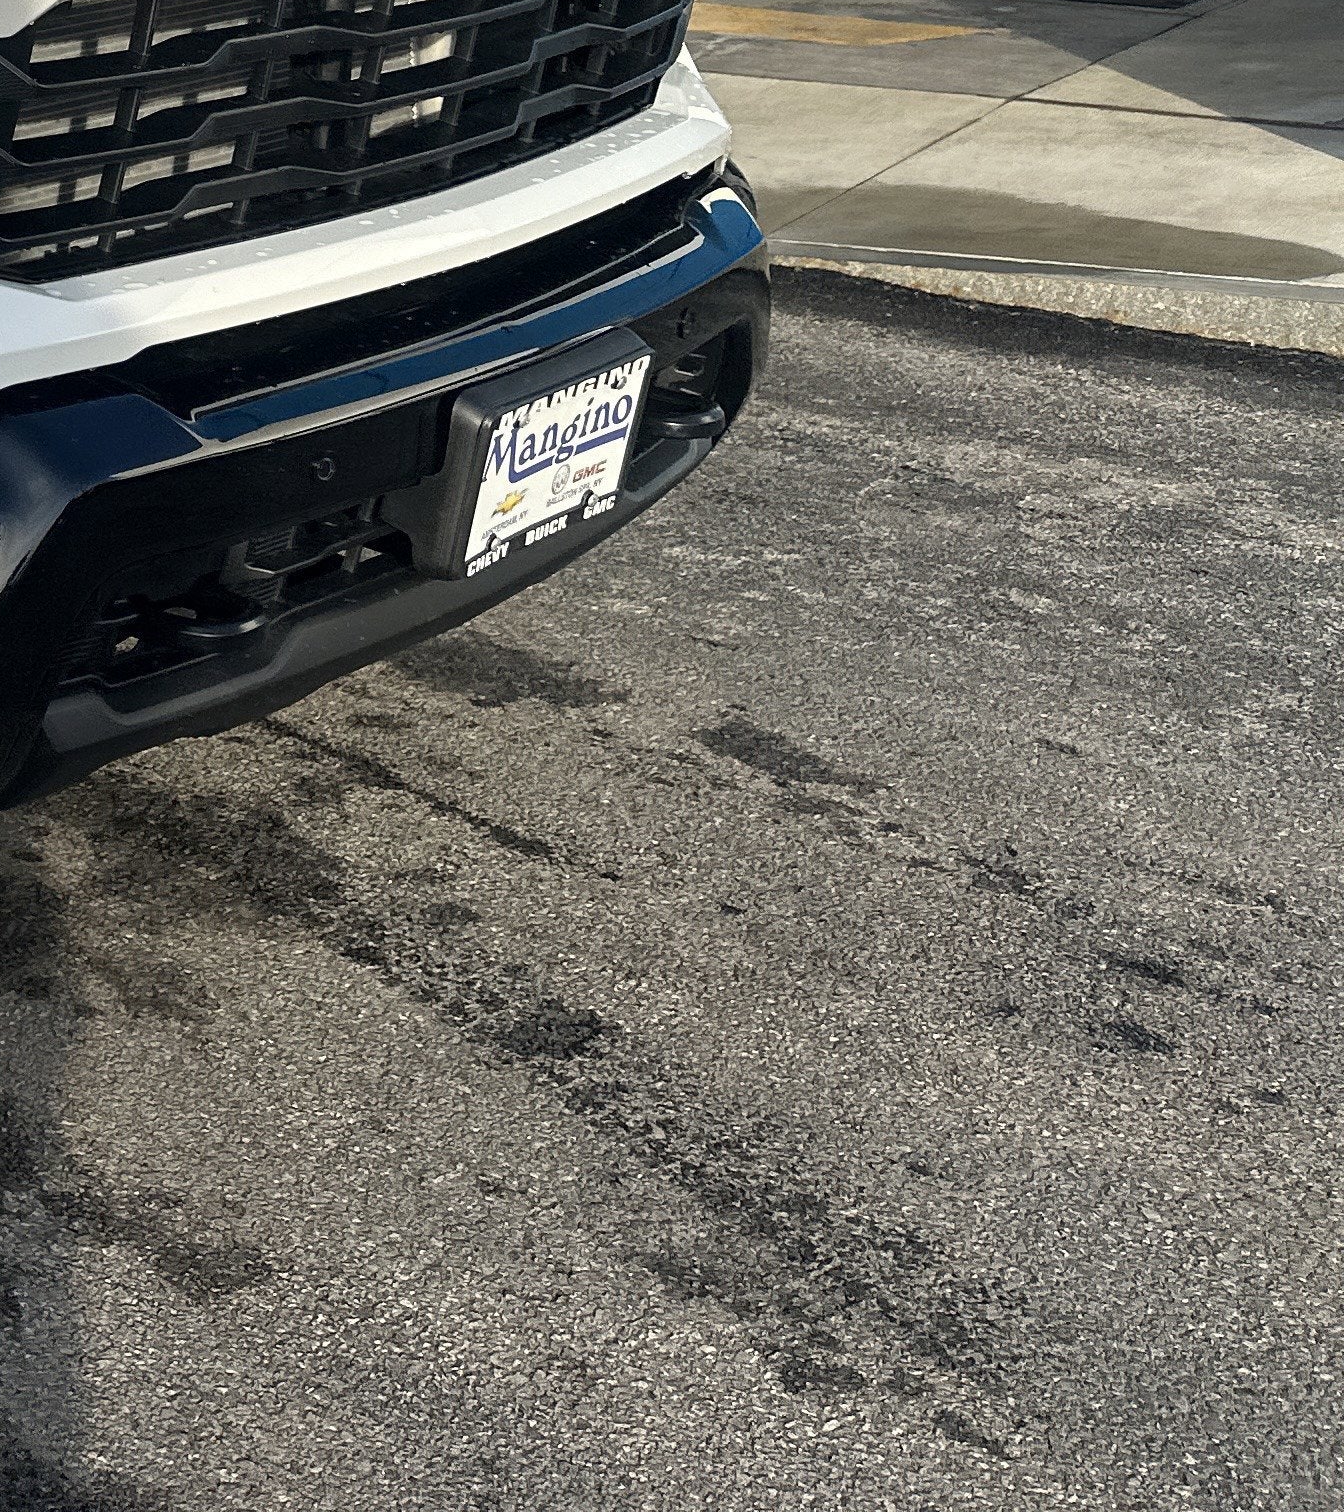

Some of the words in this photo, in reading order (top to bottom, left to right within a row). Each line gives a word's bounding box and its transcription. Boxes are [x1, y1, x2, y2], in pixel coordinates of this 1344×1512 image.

[499, 355, 651, 430] MANGINO
[483, 395, 633, 483] Mangino
[572, 459, 608, 484] GMC
[466, 542, 510, 577] CHEVY
[525, 515, 569, 546] BUICK
[582, 496, 617, 520] GMC
